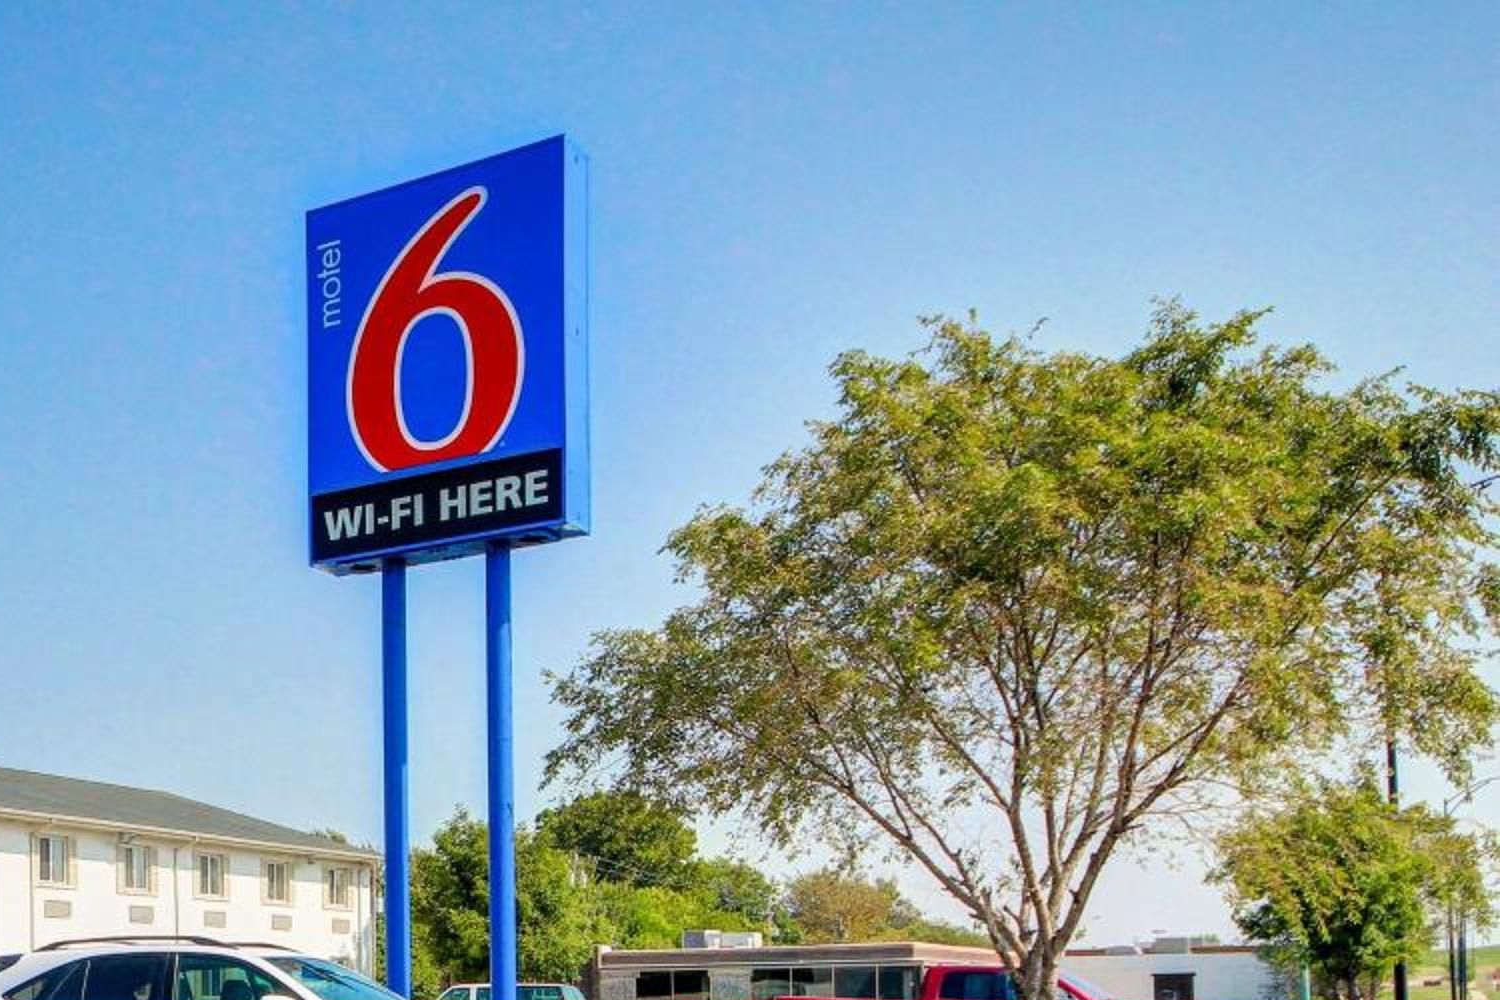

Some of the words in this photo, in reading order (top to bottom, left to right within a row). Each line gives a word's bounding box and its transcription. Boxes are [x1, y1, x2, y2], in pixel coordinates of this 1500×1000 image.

[317, 239, 341, 329] motel
[345, 185, 526, 473] 6
[323, 494, 424, 541] WI-FI
[439, 469, 549, 522] HERE
